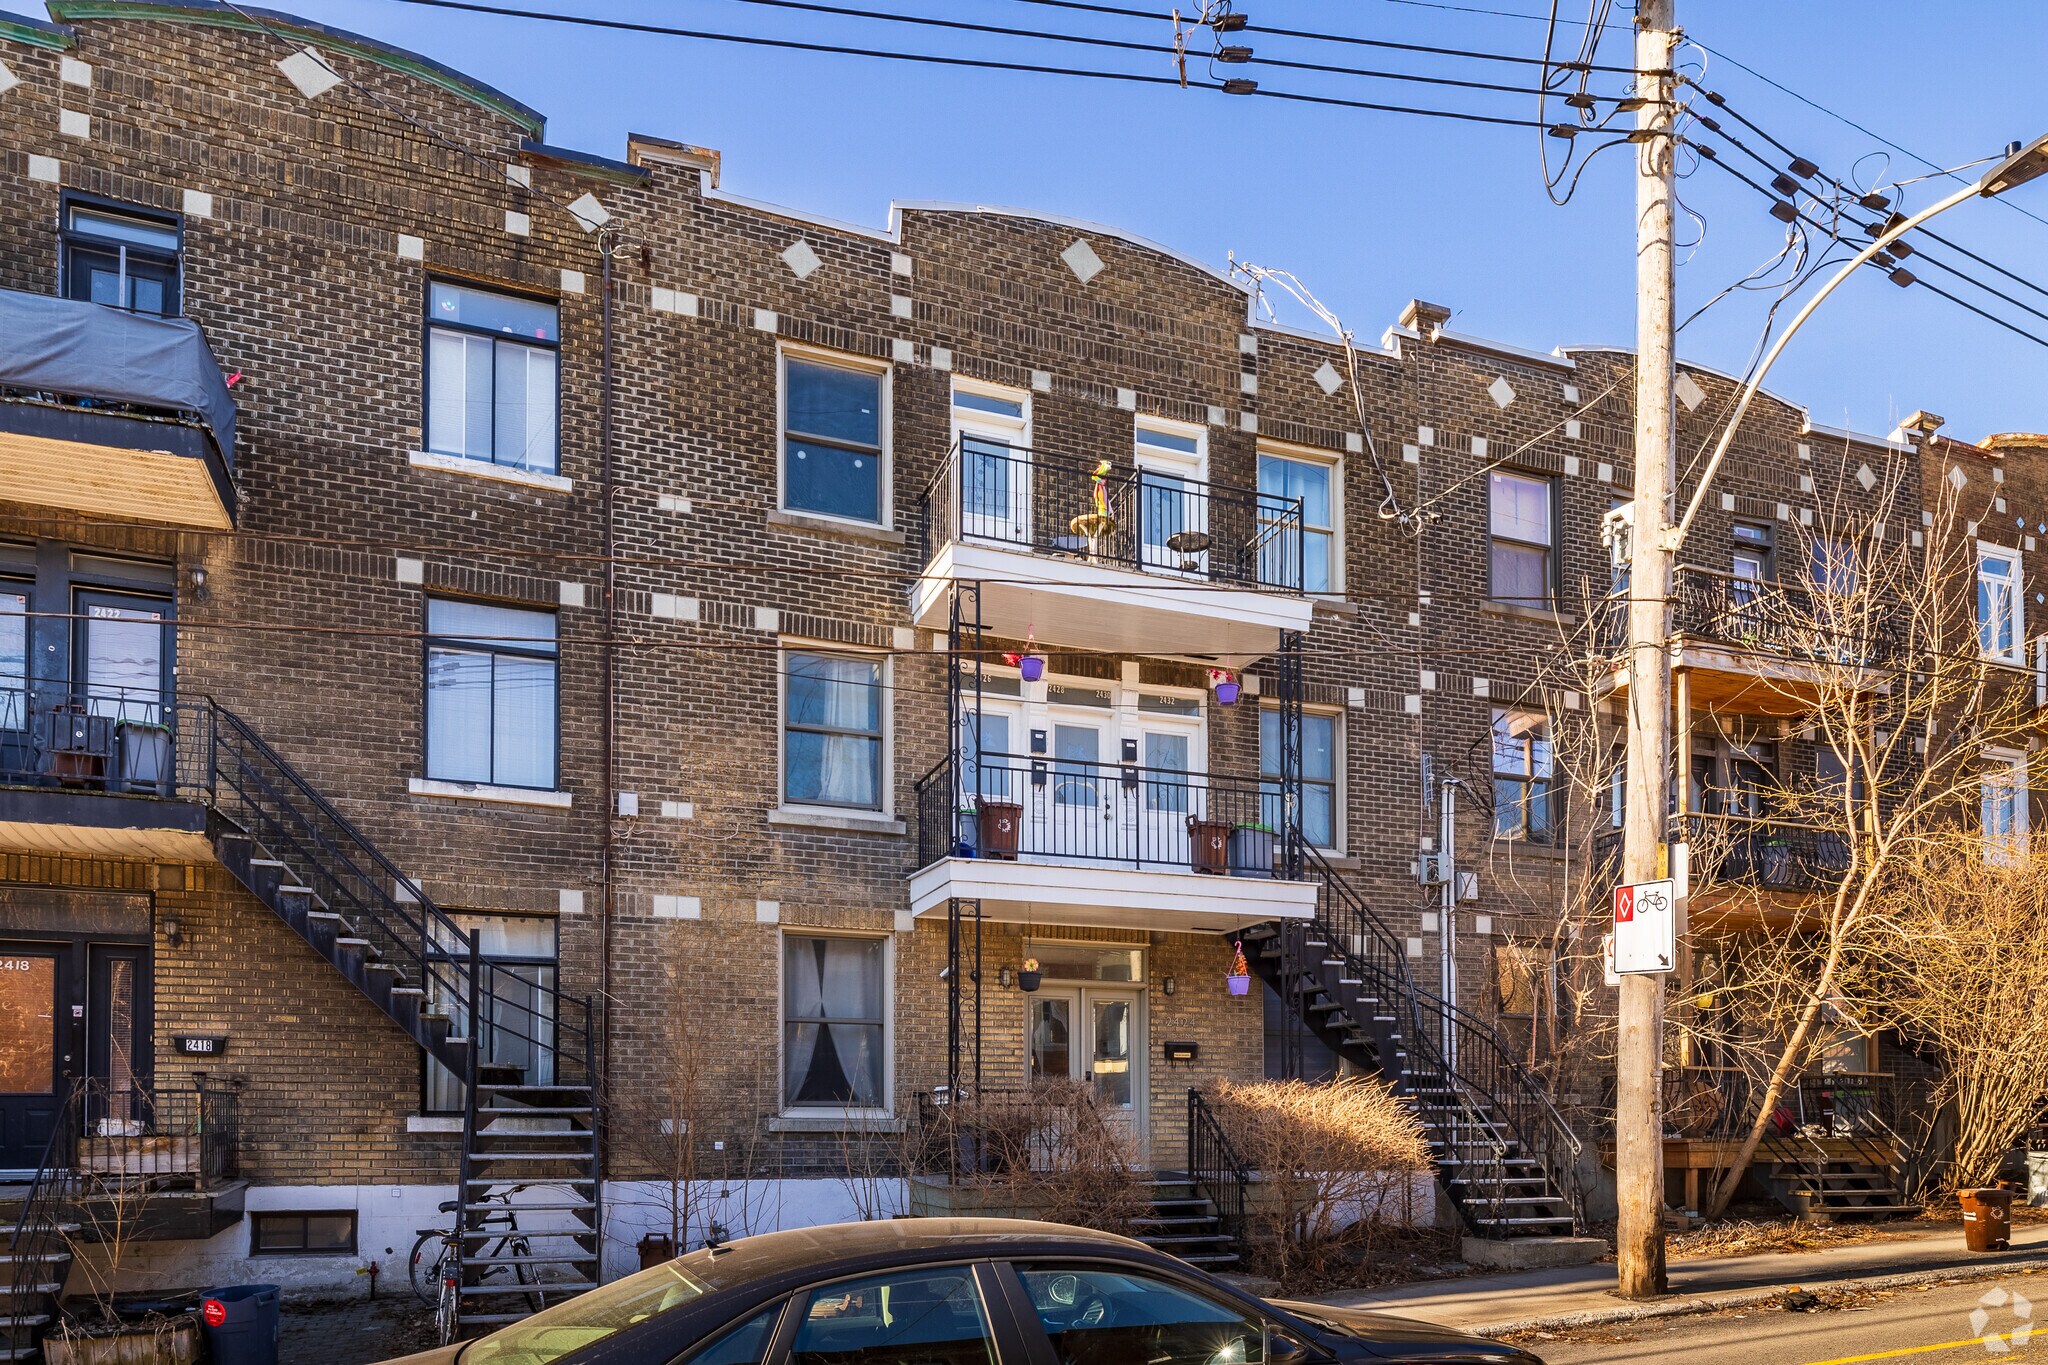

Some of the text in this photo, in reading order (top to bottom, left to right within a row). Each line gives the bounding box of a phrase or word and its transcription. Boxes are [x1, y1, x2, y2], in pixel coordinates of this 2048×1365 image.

[94, 608, 120, 618] 2422
[1048, 684, 1065, 694] 2428
[1159, 696, 1175, 705] 2432
[1166, 1017, 1196, 1027] 2424
[187, 1040, 211, 1050] 2418
